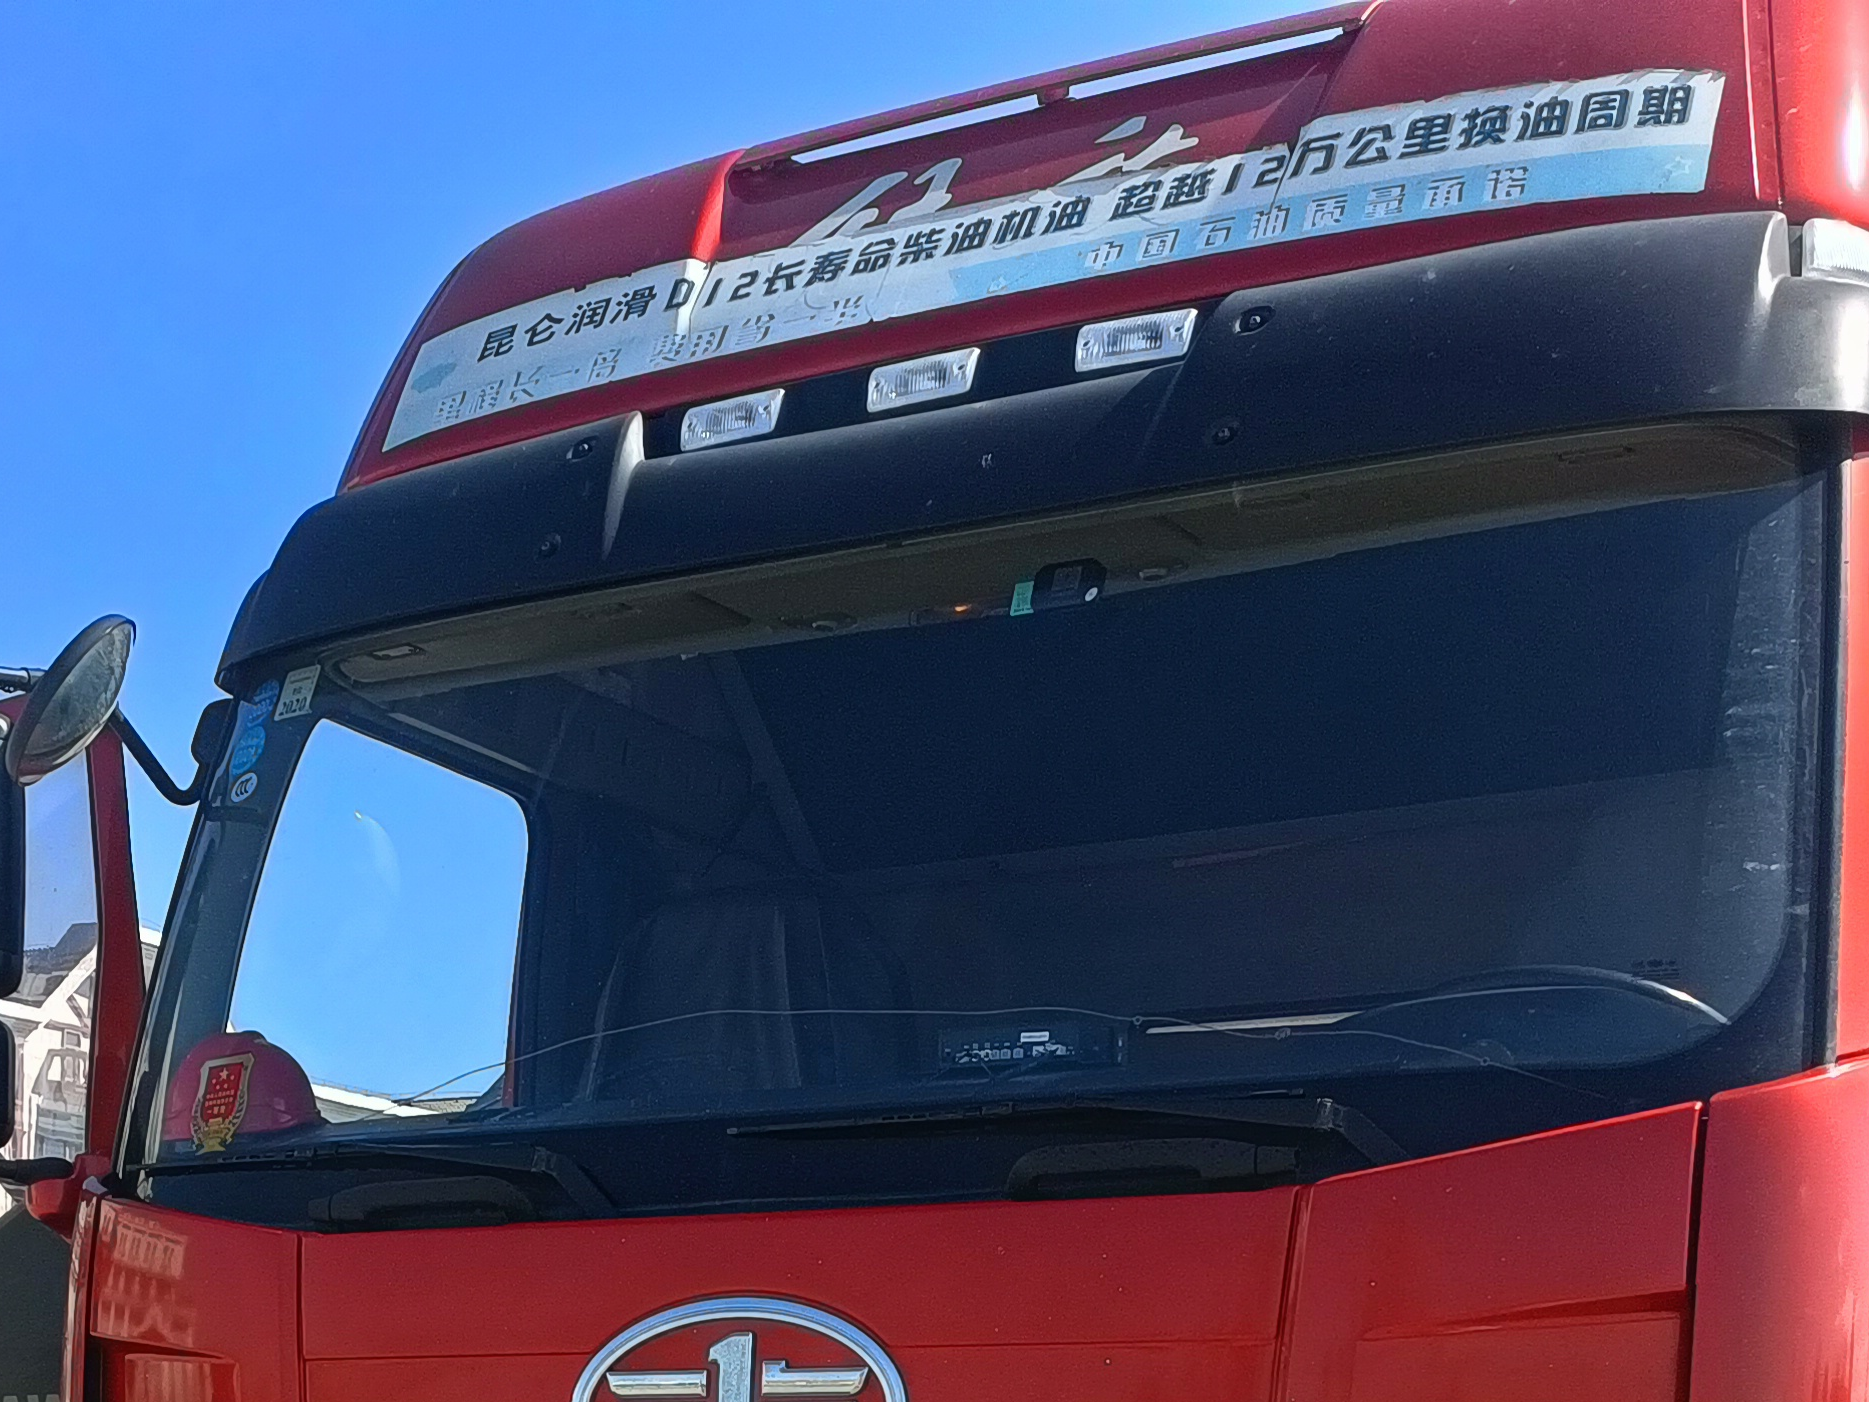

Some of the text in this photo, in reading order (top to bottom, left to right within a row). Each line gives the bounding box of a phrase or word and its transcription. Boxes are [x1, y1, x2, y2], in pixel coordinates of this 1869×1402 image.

[1110, 84, 1694, 218] 超越12万公里换油周期
[1083, 166, 1530, 272] 中国石油质量承诺
[277, 696, 308, 717] 2020
